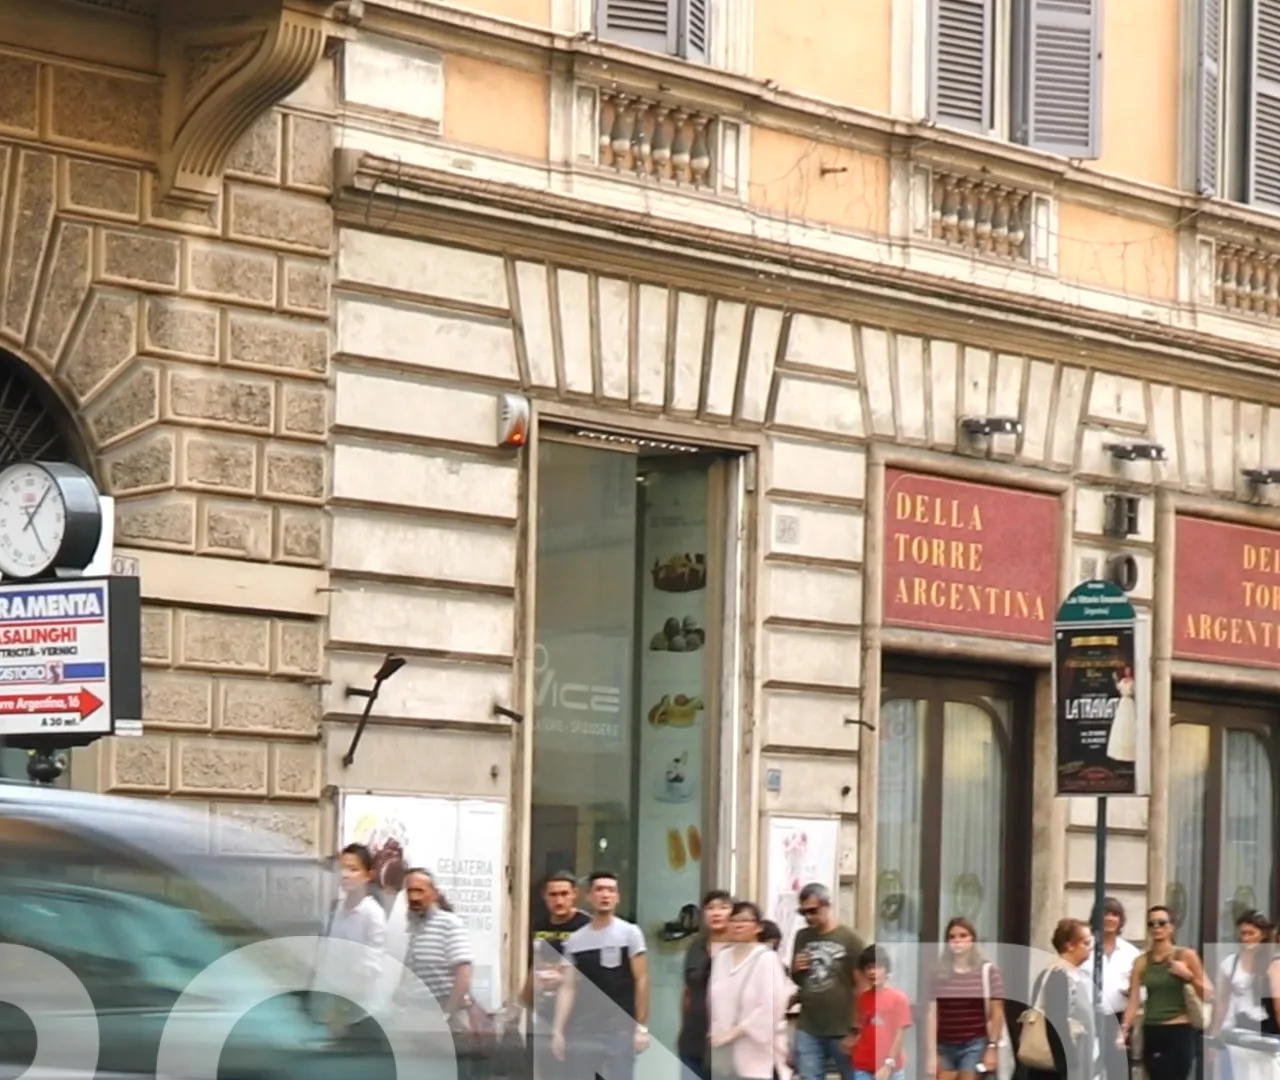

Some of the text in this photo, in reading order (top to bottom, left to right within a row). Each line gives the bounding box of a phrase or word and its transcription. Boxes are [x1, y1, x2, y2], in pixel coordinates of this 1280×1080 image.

[895, 491, 983, 532] DELLA
[895, 534, 984, 573] TORRE
[895, 577, 1046, 622] ARGENTINA
